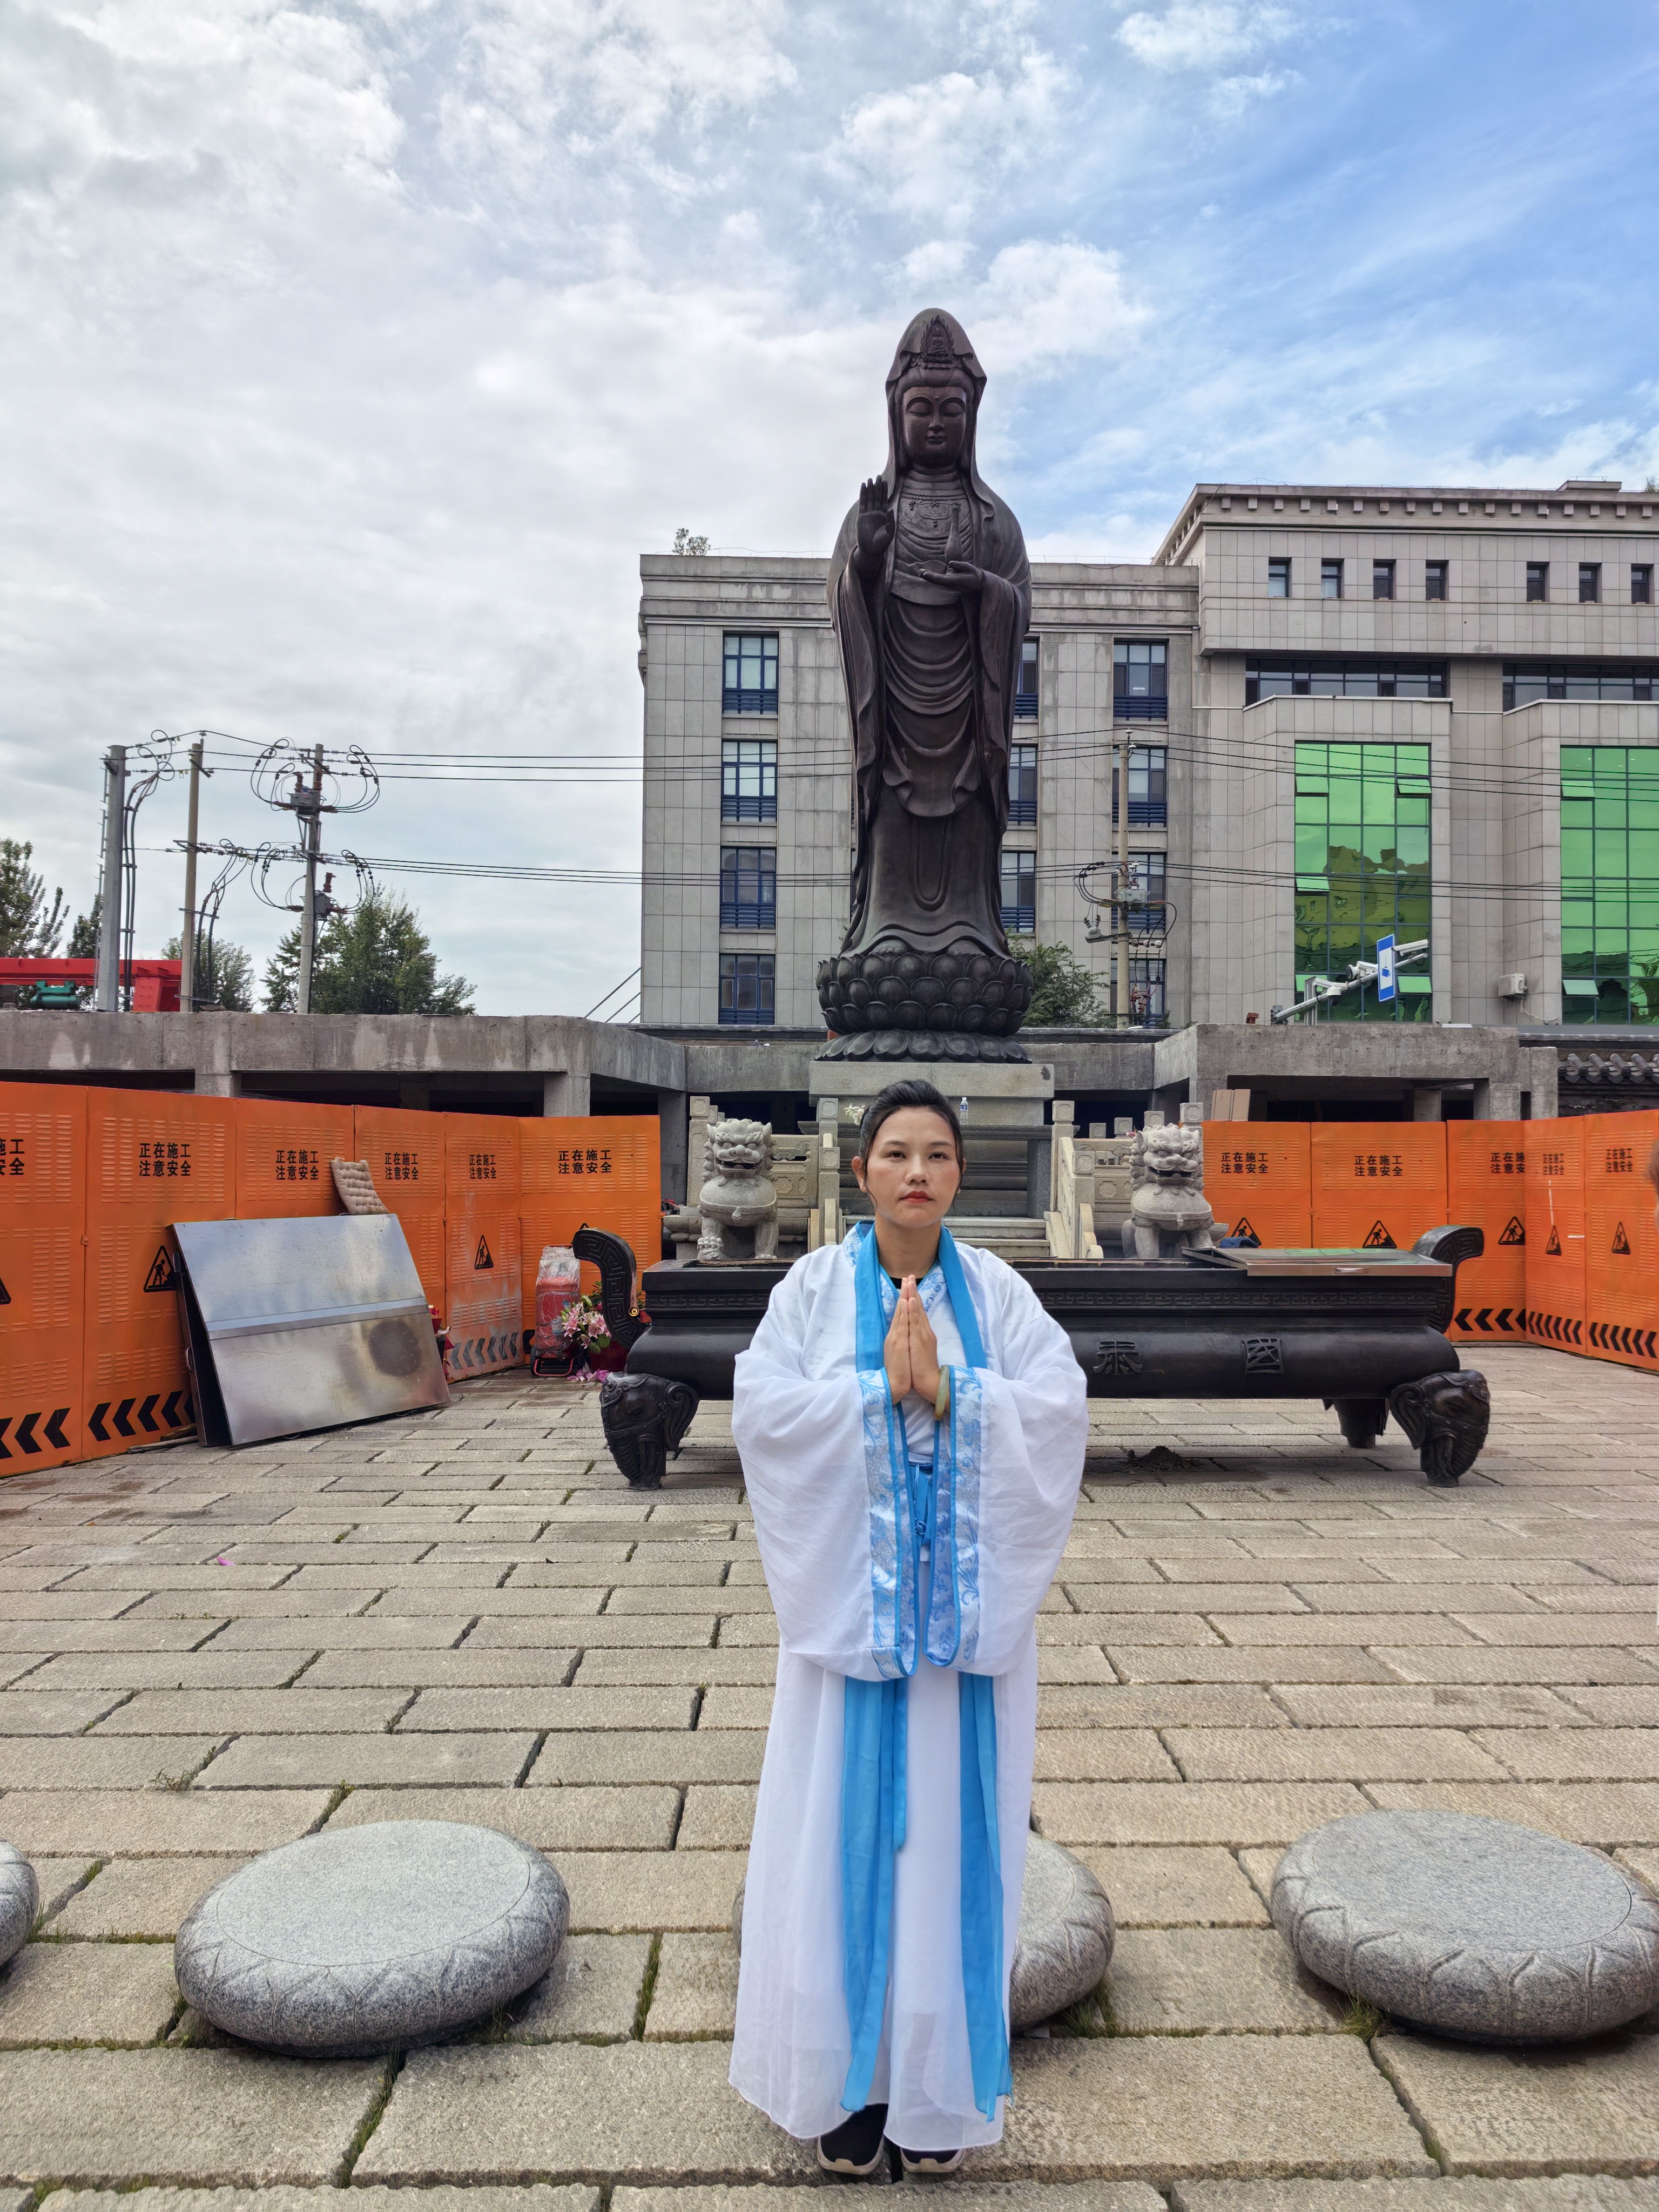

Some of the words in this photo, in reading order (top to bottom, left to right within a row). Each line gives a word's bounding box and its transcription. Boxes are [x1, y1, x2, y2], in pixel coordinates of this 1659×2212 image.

[139, 1142, 191, 1158] 正在施工
[558, 1149, 612, 1161] 正在施工
[1606, 1148, 1633, 1159] 正在施工
[275, 1150, 319, 1164] 正在施工
[385, 1152, 419, 1165] 正在施工
[469, 1154, 496, 1166] 正在施工
[1221, 1151, 1268, 1162] 正在施工
[1354, 1155, 1402, 1165] 正在施工
[1542, 1153, 1564, 1164] 正在施工
[139, 1159, 191, 1177] 注意安全
[558, 1162, 612, 1174] 注意安全
[1221, 1163, 1269, 1174] 注意安全
[1354, 1165, 1402, 1177] 注意安全
[1542, 1164, 1564, 1175] 注意安全
[1606, 1161, 1633, 1172] 注意安全
[276, 1165, 319, 1181] 注意安全
[385, 1166, 419, 1180] 注意安全
[469, 1167, 496, 1179] 注意安全
